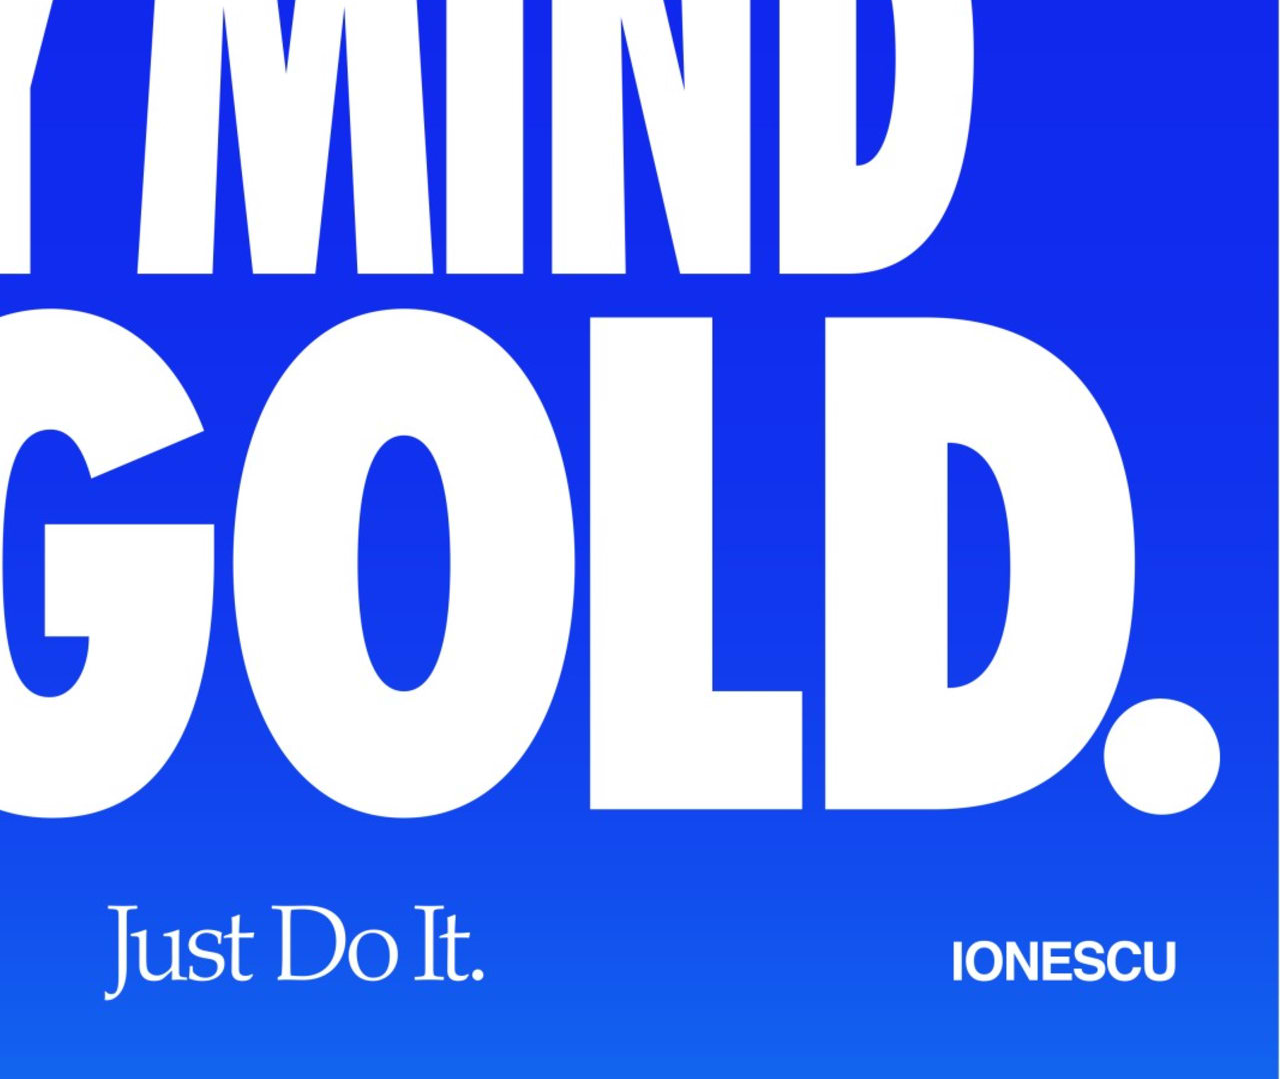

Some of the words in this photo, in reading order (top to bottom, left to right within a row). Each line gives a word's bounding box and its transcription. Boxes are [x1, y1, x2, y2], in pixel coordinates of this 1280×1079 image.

[105, 906, 254, 1000] Just
[272, 906, 398, 981] Do
[415, 906, 483, 981] It.
[954, 941, 1175, 981] IONESCU
